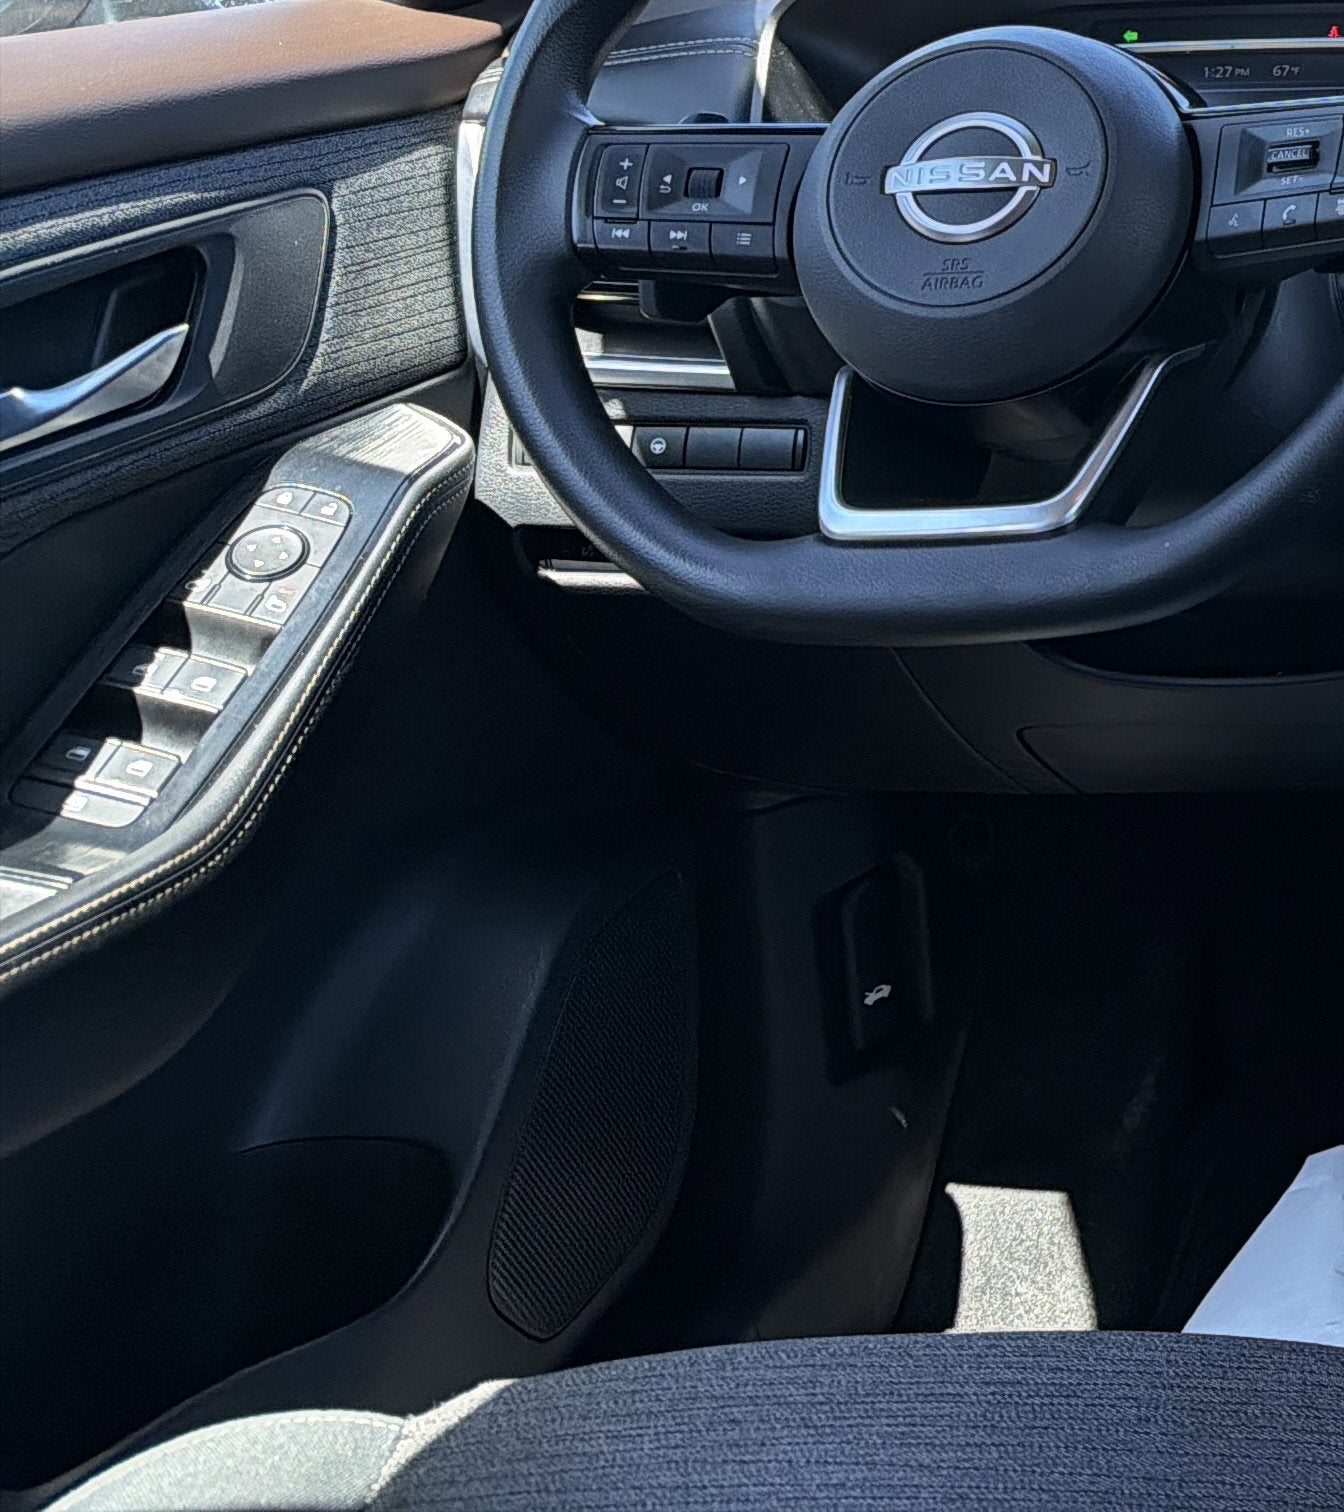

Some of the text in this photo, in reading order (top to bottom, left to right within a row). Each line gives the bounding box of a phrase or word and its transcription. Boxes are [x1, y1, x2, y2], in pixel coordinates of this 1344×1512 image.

[1203, 65, 1250, 79] 1:27 PM
[1269, 148, 1308, 161] CANCEL
[890, 161, 1052, 188] NISSAN
[691, 202, 710, 213] OK
[940, 257, 970, 272] SRS
[921, 275, 985, 291] AIRBAG
